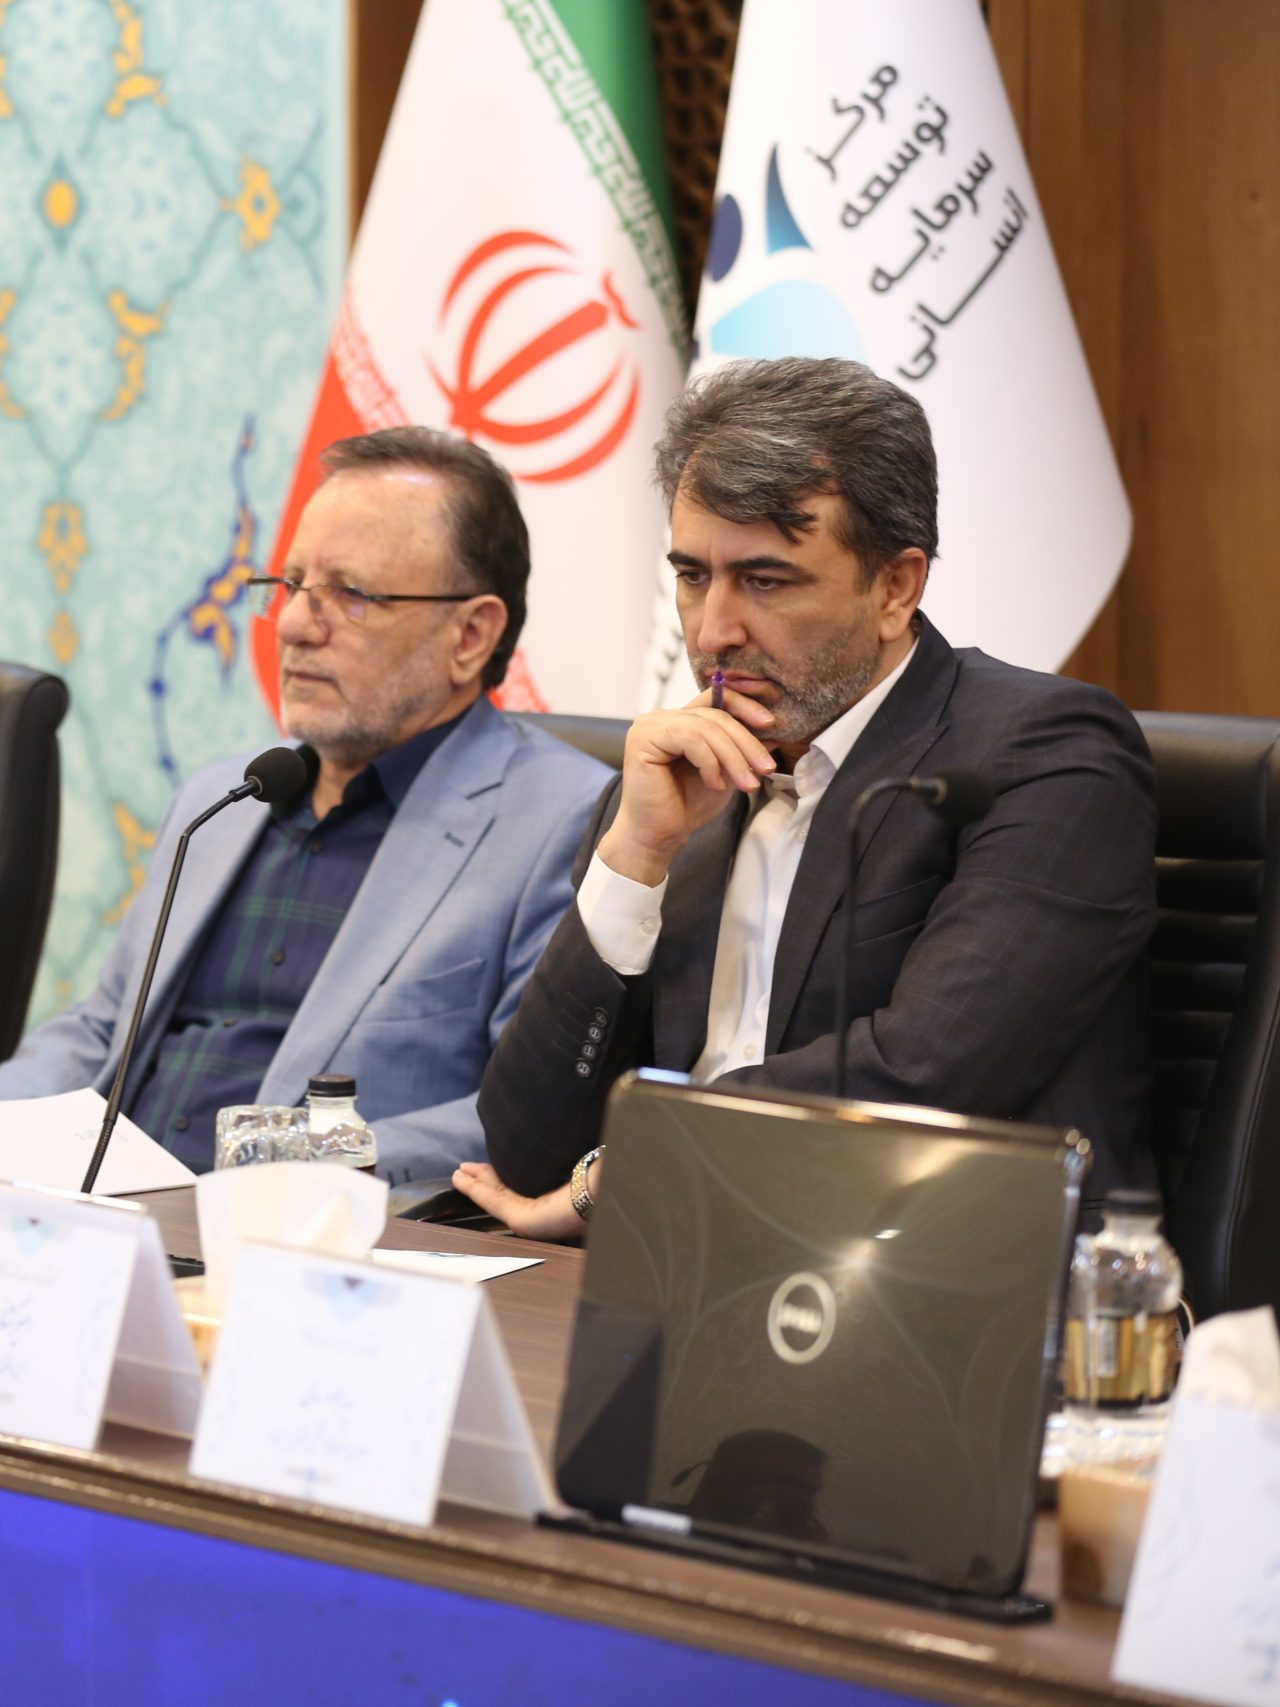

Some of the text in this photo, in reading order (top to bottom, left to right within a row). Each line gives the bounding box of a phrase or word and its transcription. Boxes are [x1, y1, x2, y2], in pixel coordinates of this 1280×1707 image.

[806, 63, 900, 184] مرکز
[840, 94, 950, 231] توسعه
[869, 149, 995, 295] سرمایه
[895, 185, 1031, 382] انسانی
